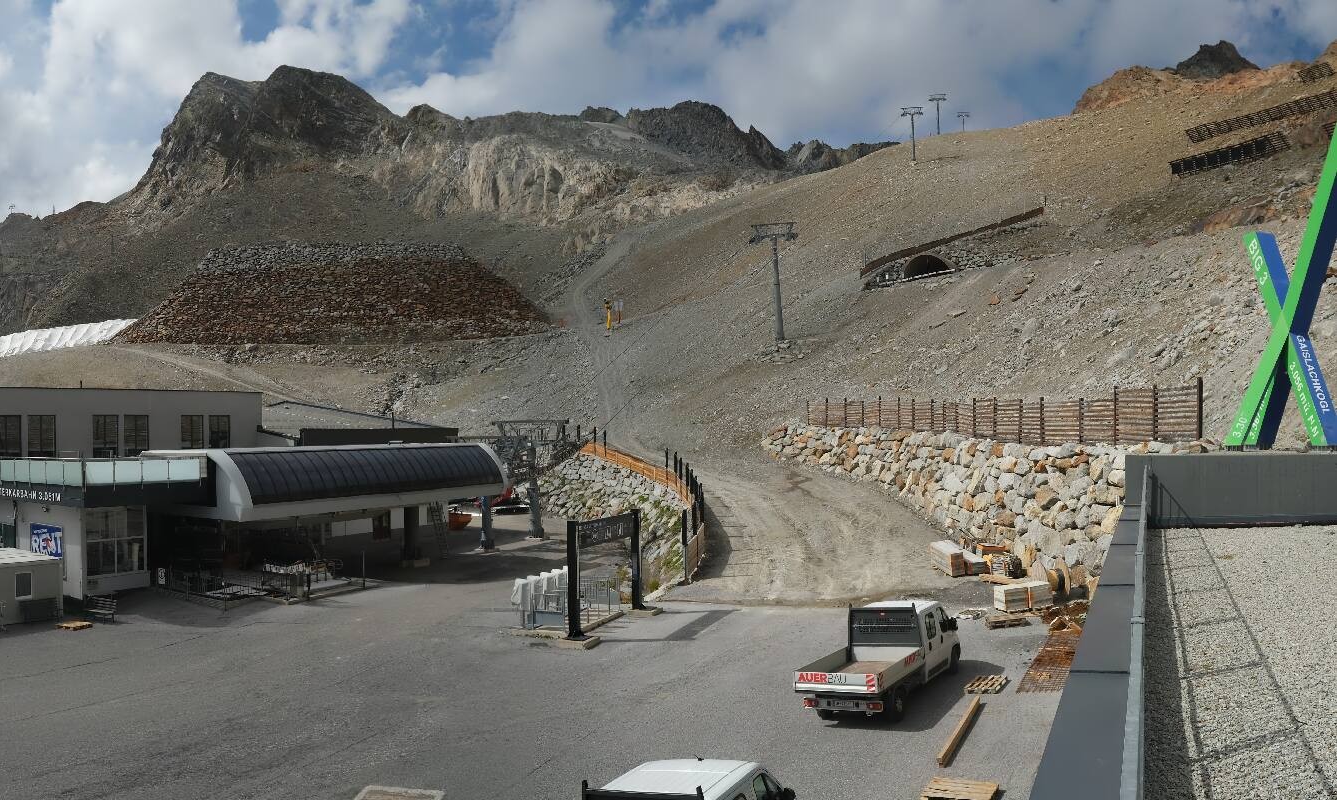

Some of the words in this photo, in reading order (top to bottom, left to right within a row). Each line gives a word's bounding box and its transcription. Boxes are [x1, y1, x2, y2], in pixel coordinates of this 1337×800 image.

[1248, 238, 1264, 271] BIG
[1259, 271, 1268, 286] 3
[1296, 335, 1331, 415] GAISLACHKOGL
